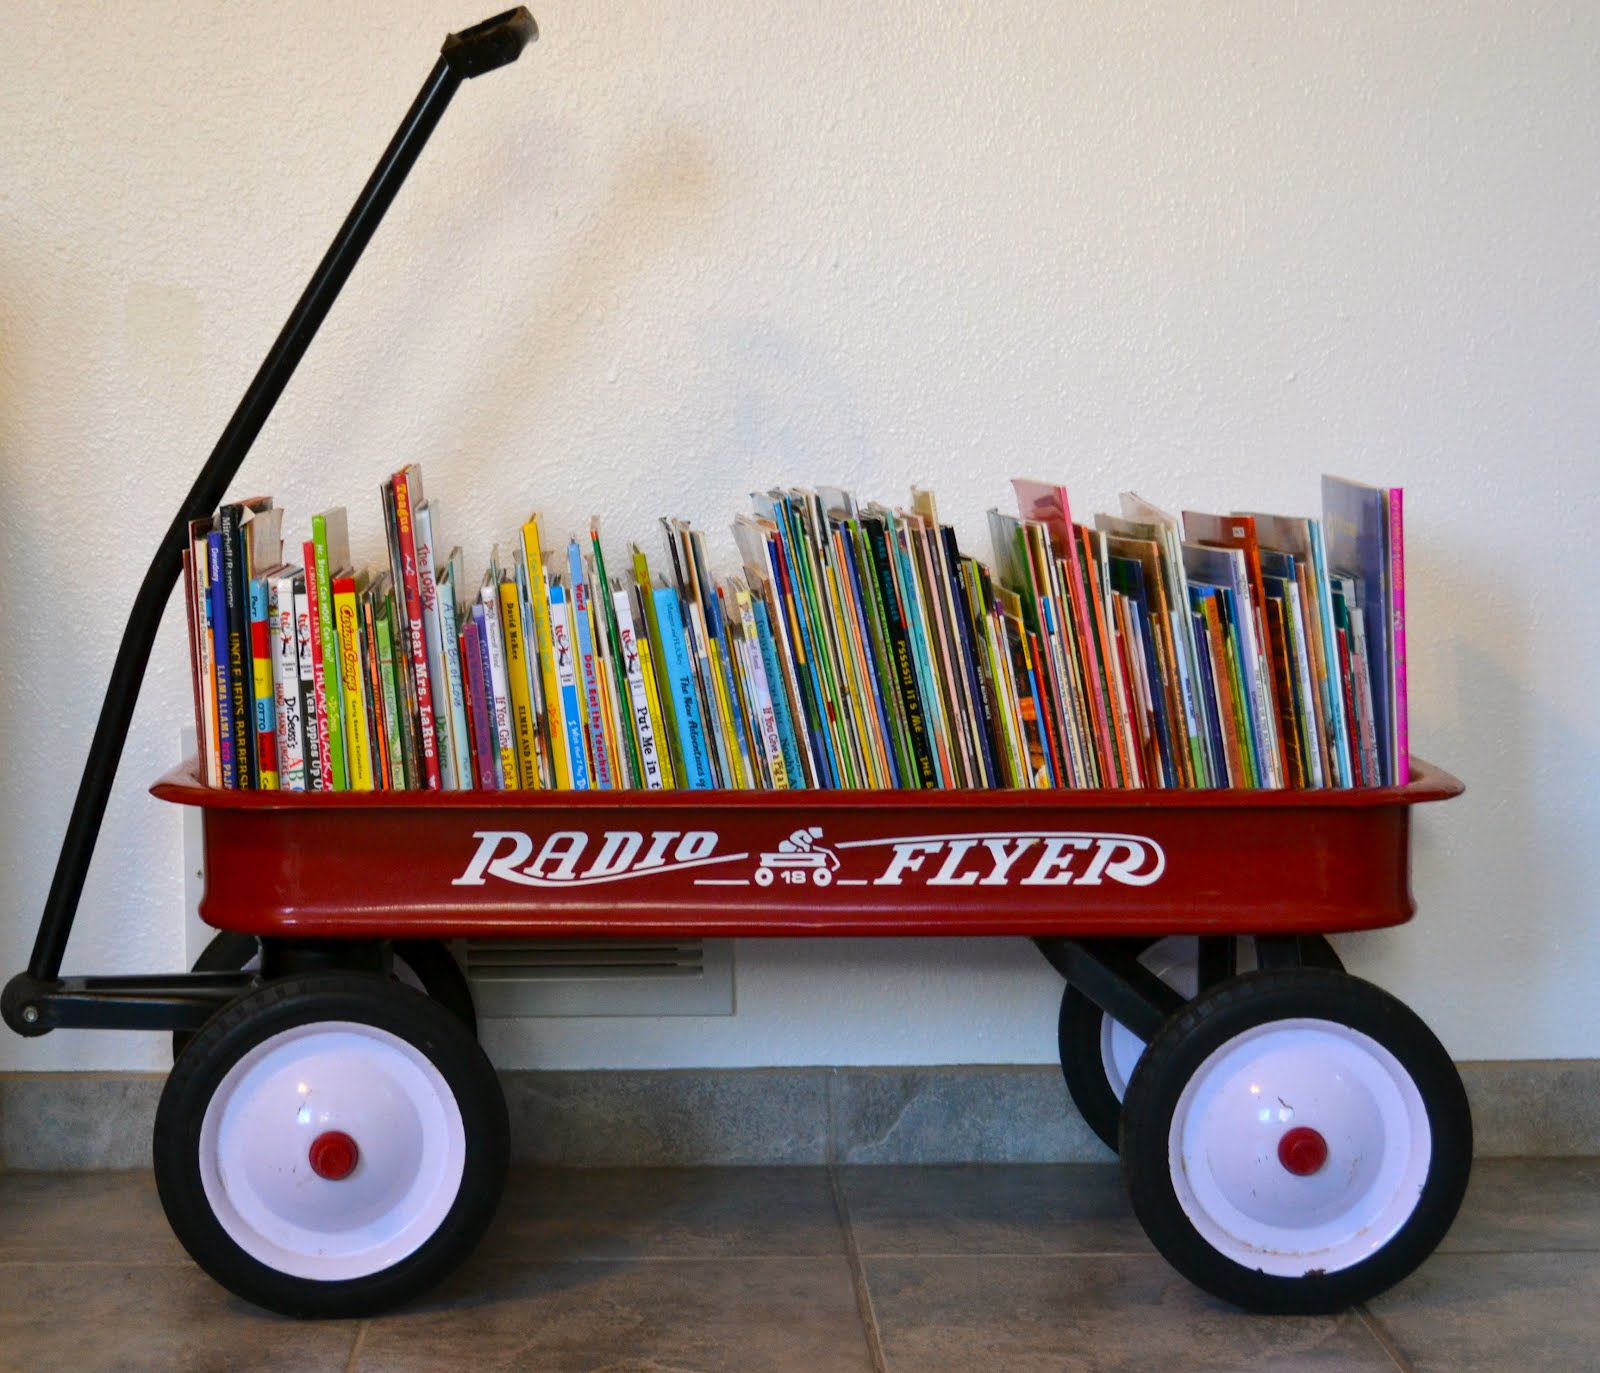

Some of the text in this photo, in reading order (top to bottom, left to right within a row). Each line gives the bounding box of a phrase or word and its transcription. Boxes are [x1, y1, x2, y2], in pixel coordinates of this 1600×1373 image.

[396, 483, 410, 534] Teague
[211, 547, 220, 582] Dewdney
[317, 559, 326, 585] Brown
[416, 543, 435, 613] The LORAX
[251, 595, 259, 618] Parr
[319, 586, 328, 602] Can
[574, 583, 586, 612] Word
[443, 602, 453, 613] A
[323, 627, 331, 642] Can
[506, 602, 519, 661] David McKee
[229, 632, 242, 678] UNCLE
[324, 643, 334, 663] You?
[340, 605, 358, 693] Curious George
[216, 664, 227, 701] LLAMA
[410, 618, 434, 758] Dear Mrs. LaRue
[679, 674, 691, 696] The
[284, 697, 296, 714] Dr.
[306, 690, 315, 714] Ten
[495, 696, 505, 705] If
[683, 696, 695, 718] New
[763, 706, 772, 715] If
[218, 703, 230, 740] LLAMA
[257, 702, 267, 732] OTTO
[435, 714, 446, 732] Dr.
[496, 706, 507, 727] You
[518, 704, 529, 737] ELMER
[584, 653, 610, 784] Don't Eat the Teacher!
[636, 705, 650, 733] Put
[764, 715, 775, 733] You
[287, 715, 300, 749] Seuss's
[306, 716, 320, 758] Apples
[498, 728, 510, 754] Give
[641, 735, 654, 755] Me
[768, 734, 780, 753] Give
[319, 718, 333, 779] QUACK,
[521, 738, 532, 758] AND
[687, 719, 705, 777] Adventures
[911, 714, 923, 734] ME
[919, 755, 932, 777] THE
[309, 760, 322, 776] Up
[503, 763, 514, 780] Cat
[646, 760, 657, 776] in
[771, 760, 784, 776] Pig
[452, 830, 1168, 888] RADIO 18 FLYER
